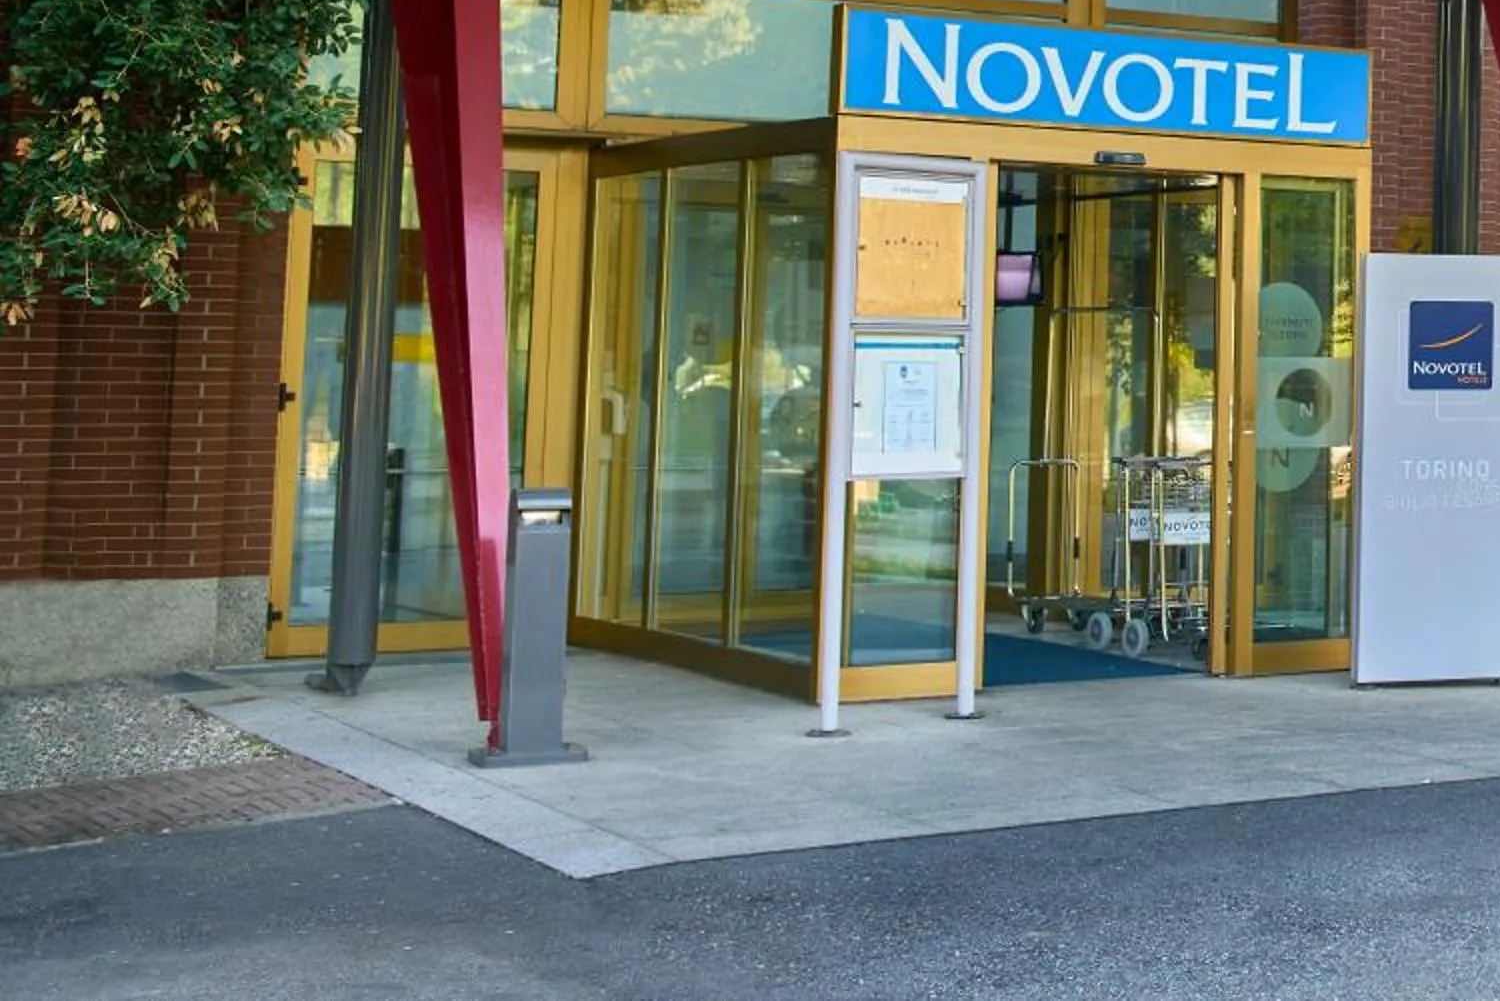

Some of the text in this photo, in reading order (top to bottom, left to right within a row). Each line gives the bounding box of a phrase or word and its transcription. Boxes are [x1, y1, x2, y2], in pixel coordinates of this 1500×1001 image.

[882, 18, 1337, 134] NOVOTEL
[1413, 360, 1487, 375] NOVOTEL
[1400, 459, 1490, 481] TORINO
